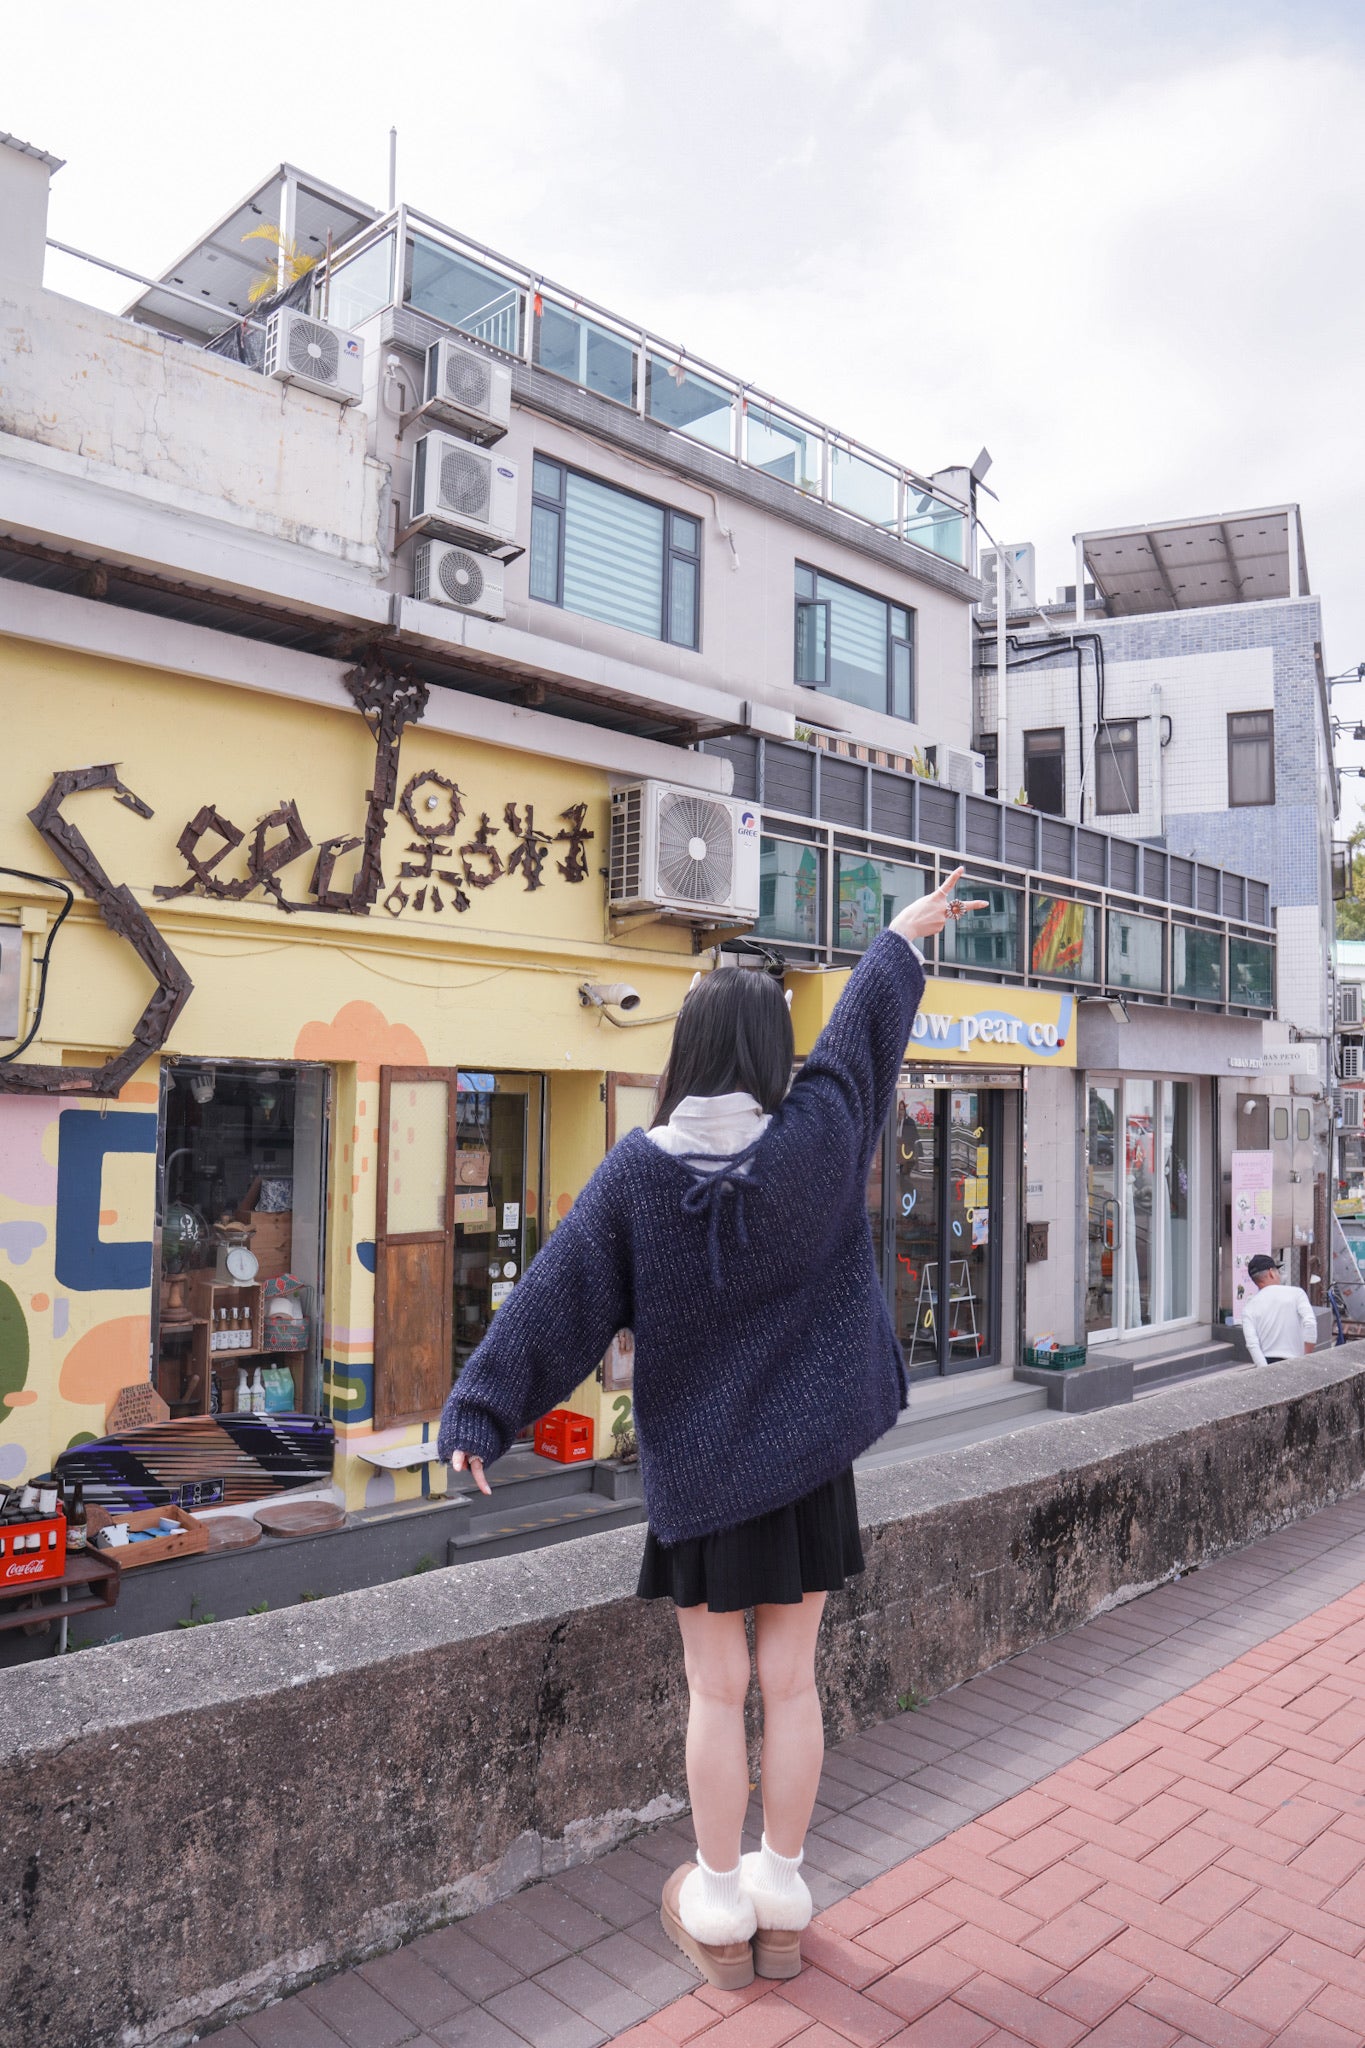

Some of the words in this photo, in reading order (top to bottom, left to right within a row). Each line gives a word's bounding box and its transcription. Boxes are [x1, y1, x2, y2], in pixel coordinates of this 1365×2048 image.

[738, 827, 758, 837] GREE
[0, 648, 430, 1098] Seed
[912, 1013, 952, 1039] ow
[959, 1016, 1022, 1052] pear
